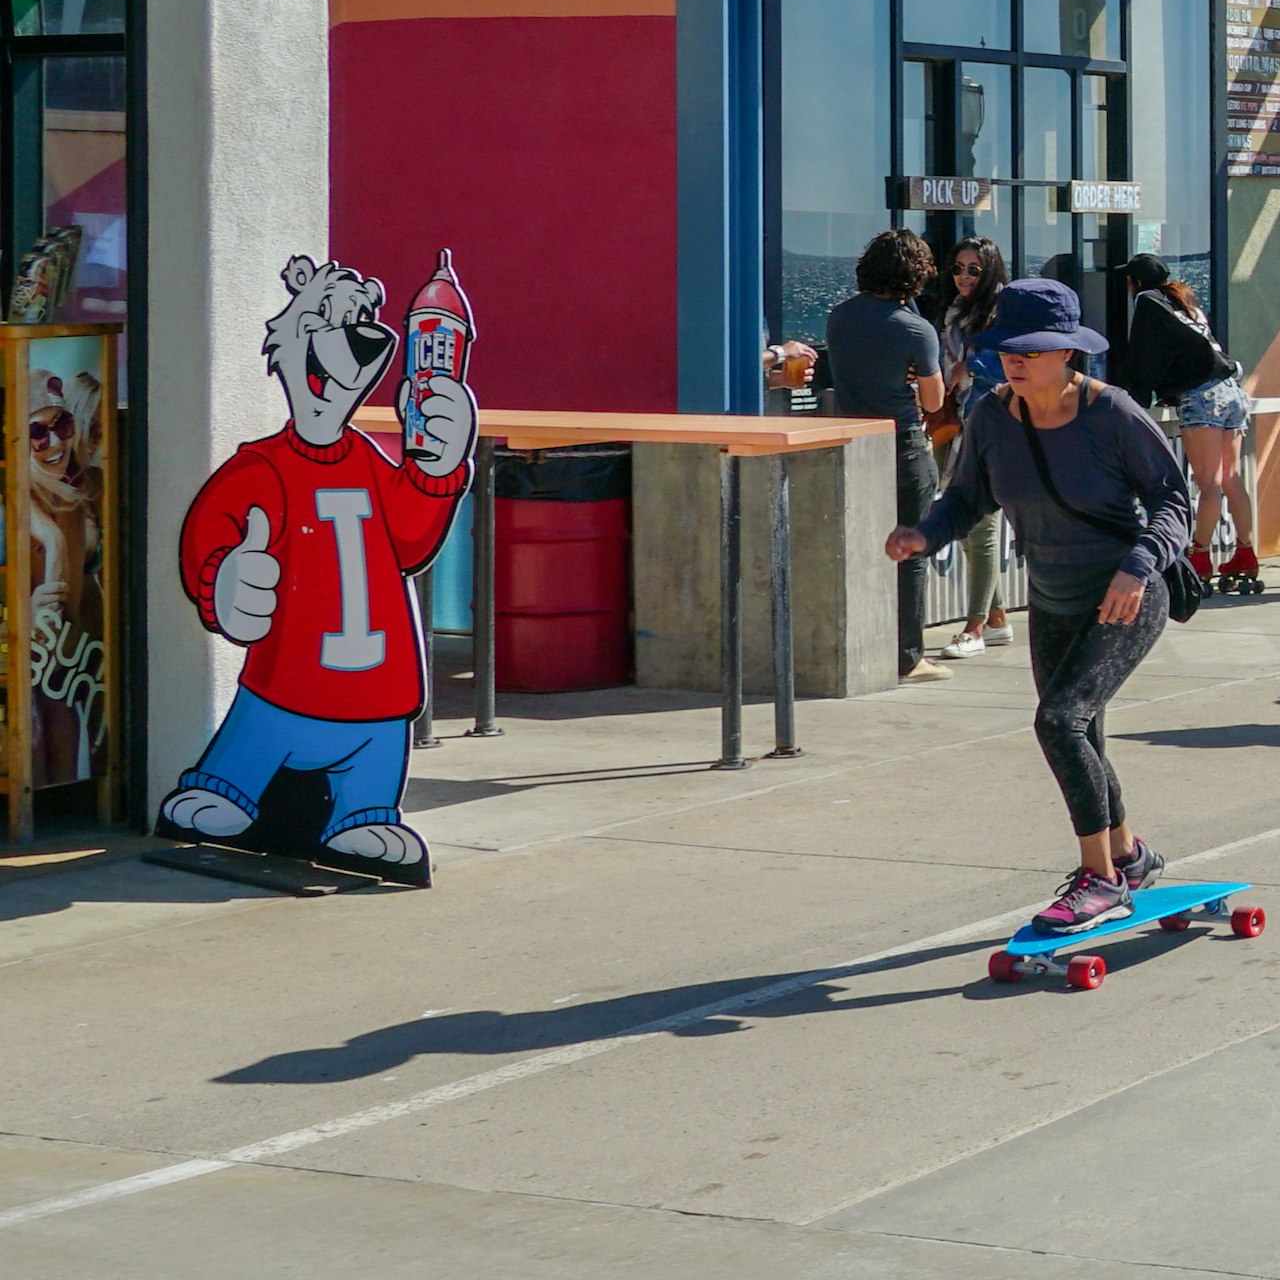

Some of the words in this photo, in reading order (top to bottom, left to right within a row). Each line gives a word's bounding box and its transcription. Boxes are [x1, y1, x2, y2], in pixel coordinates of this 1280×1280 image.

[1228, 55, 1260, 72] OQUITO
[922, 179, 954, 206] PICK
[962, 180, 980, 206] UP
[1074, 184, 1110, 209] ORDER
[1113, 186, 1141, 209] HERE
[414, 331, 456, 372] ICEE
[314, 488, 386, 671] I
